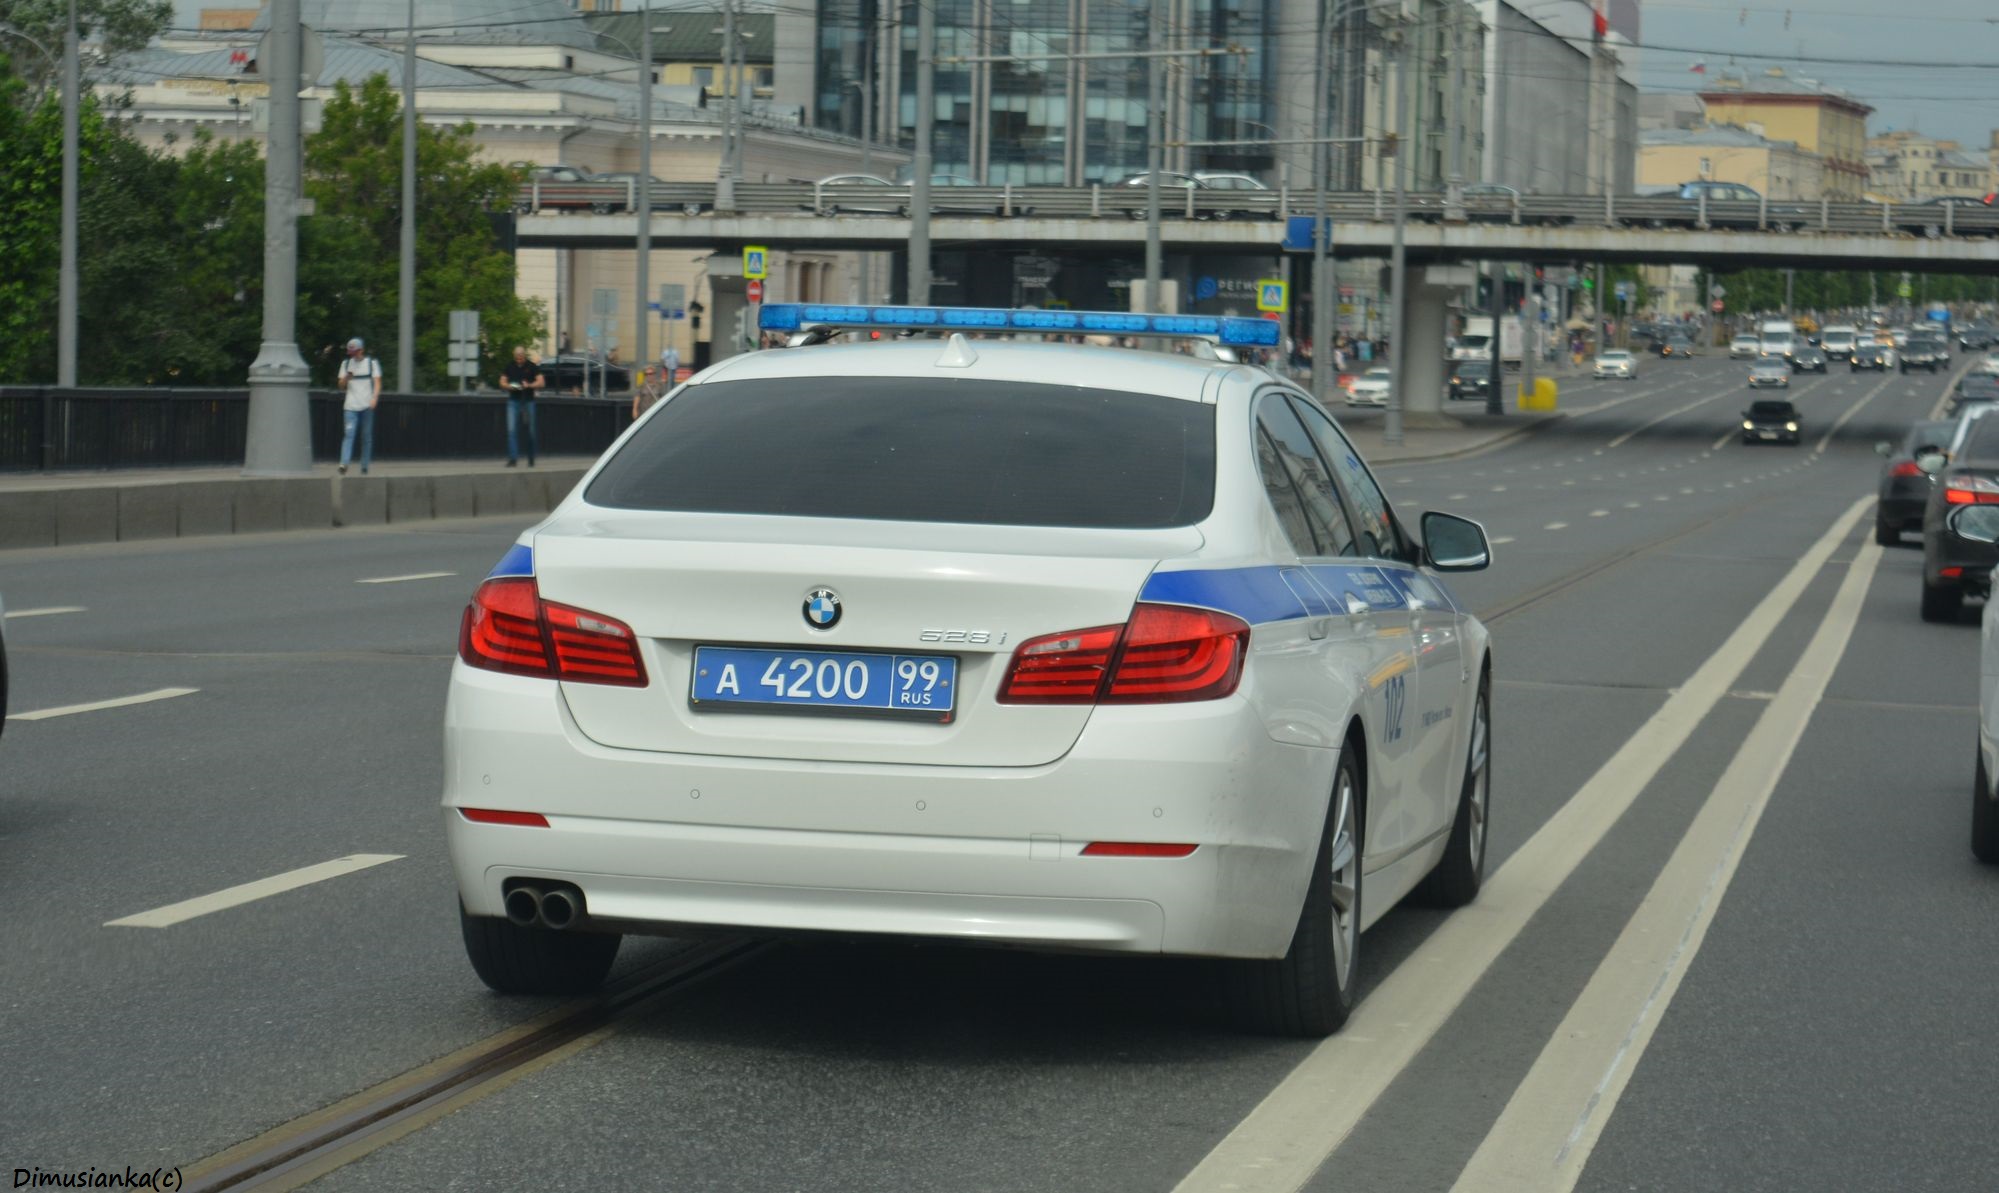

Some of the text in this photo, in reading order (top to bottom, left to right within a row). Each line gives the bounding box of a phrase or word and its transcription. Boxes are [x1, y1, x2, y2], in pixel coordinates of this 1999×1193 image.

[919, 629, 991, 644] 528
[715, 657, 940, 700] A 4200 99
[901, 692, 932, 705] RUS
[1383, 674, 1405, 743] 102
